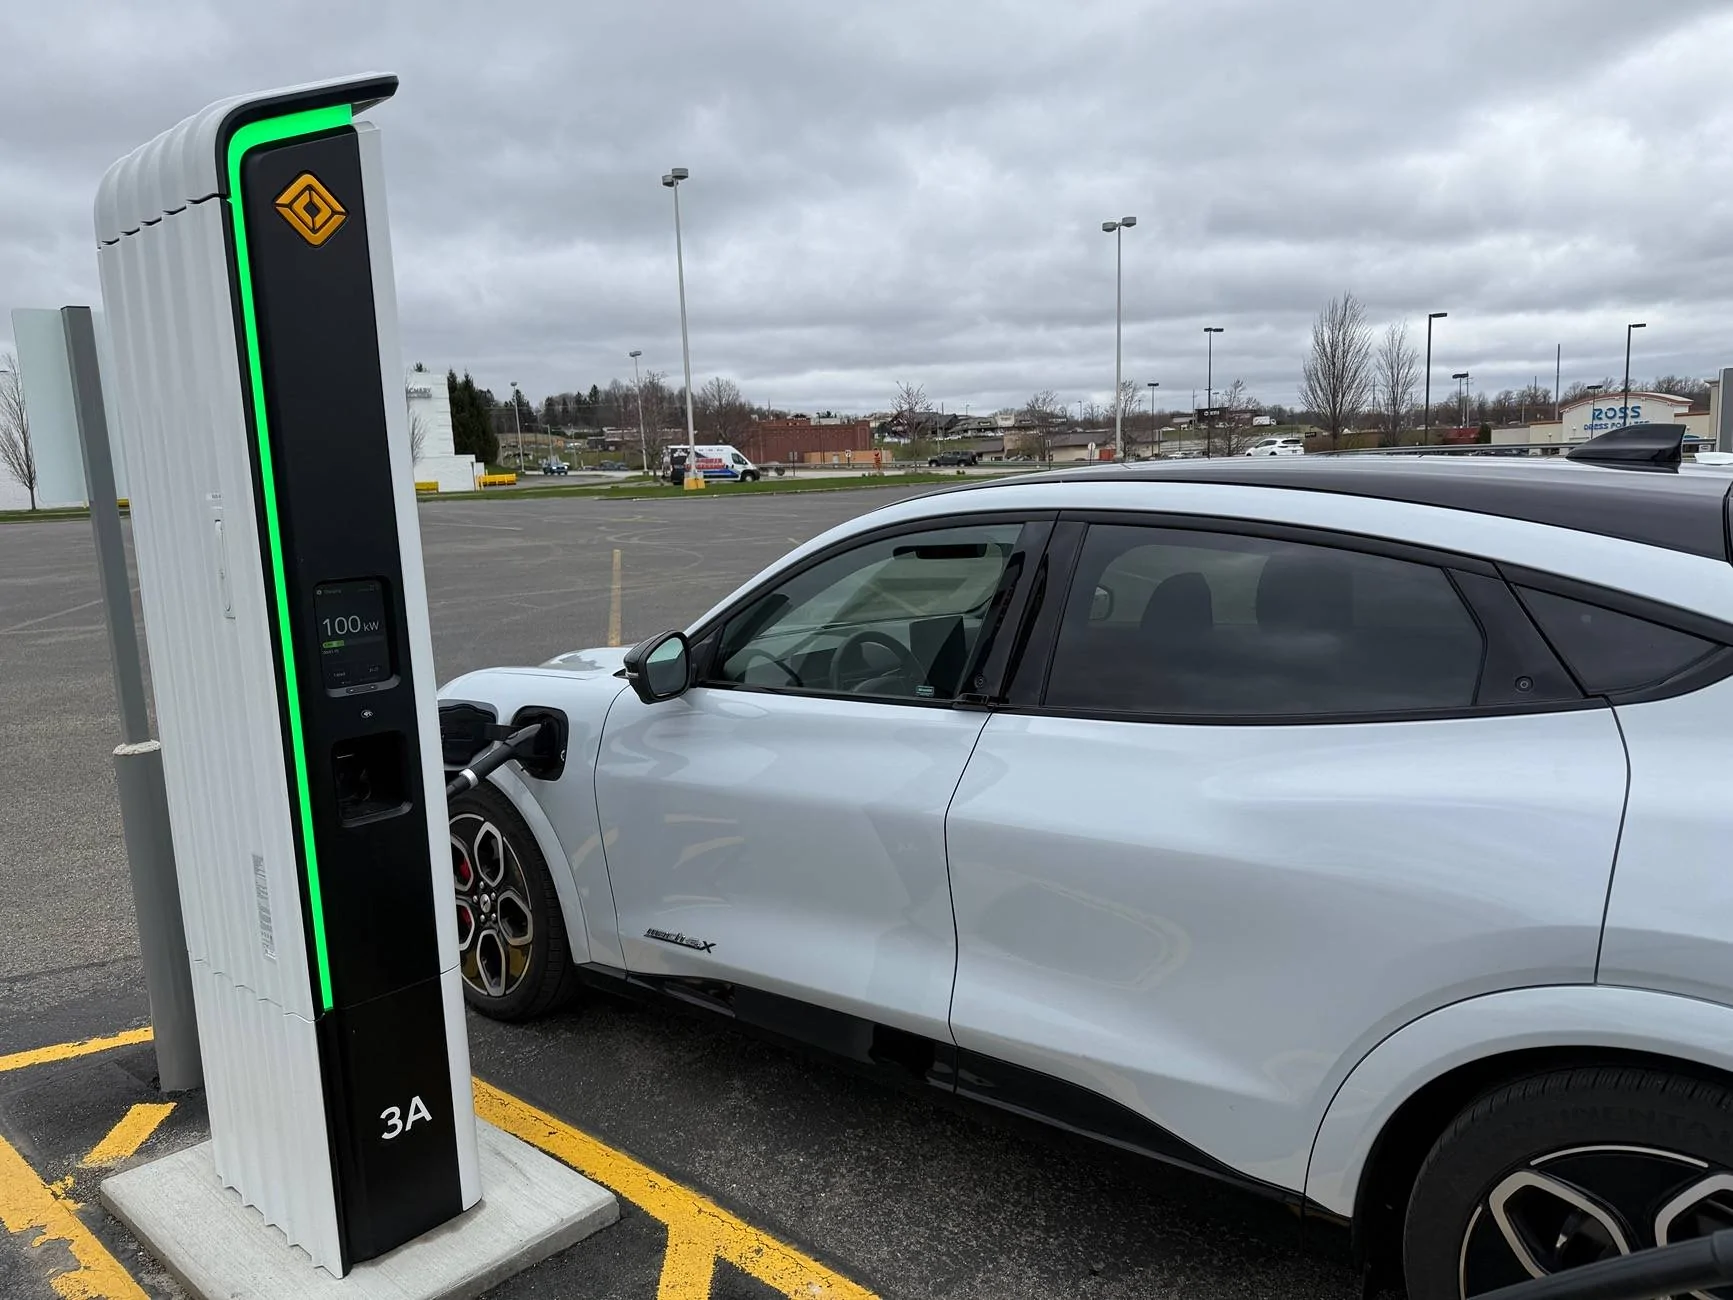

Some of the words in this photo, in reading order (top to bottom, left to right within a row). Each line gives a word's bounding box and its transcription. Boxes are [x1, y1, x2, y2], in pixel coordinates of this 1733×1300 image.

[1593, 406, 1641, 420] ROSS
[323, 616, 361, 636] 100
[363, 621, 379, 632] kW
[380, 1095, 432, 1140] 3A
